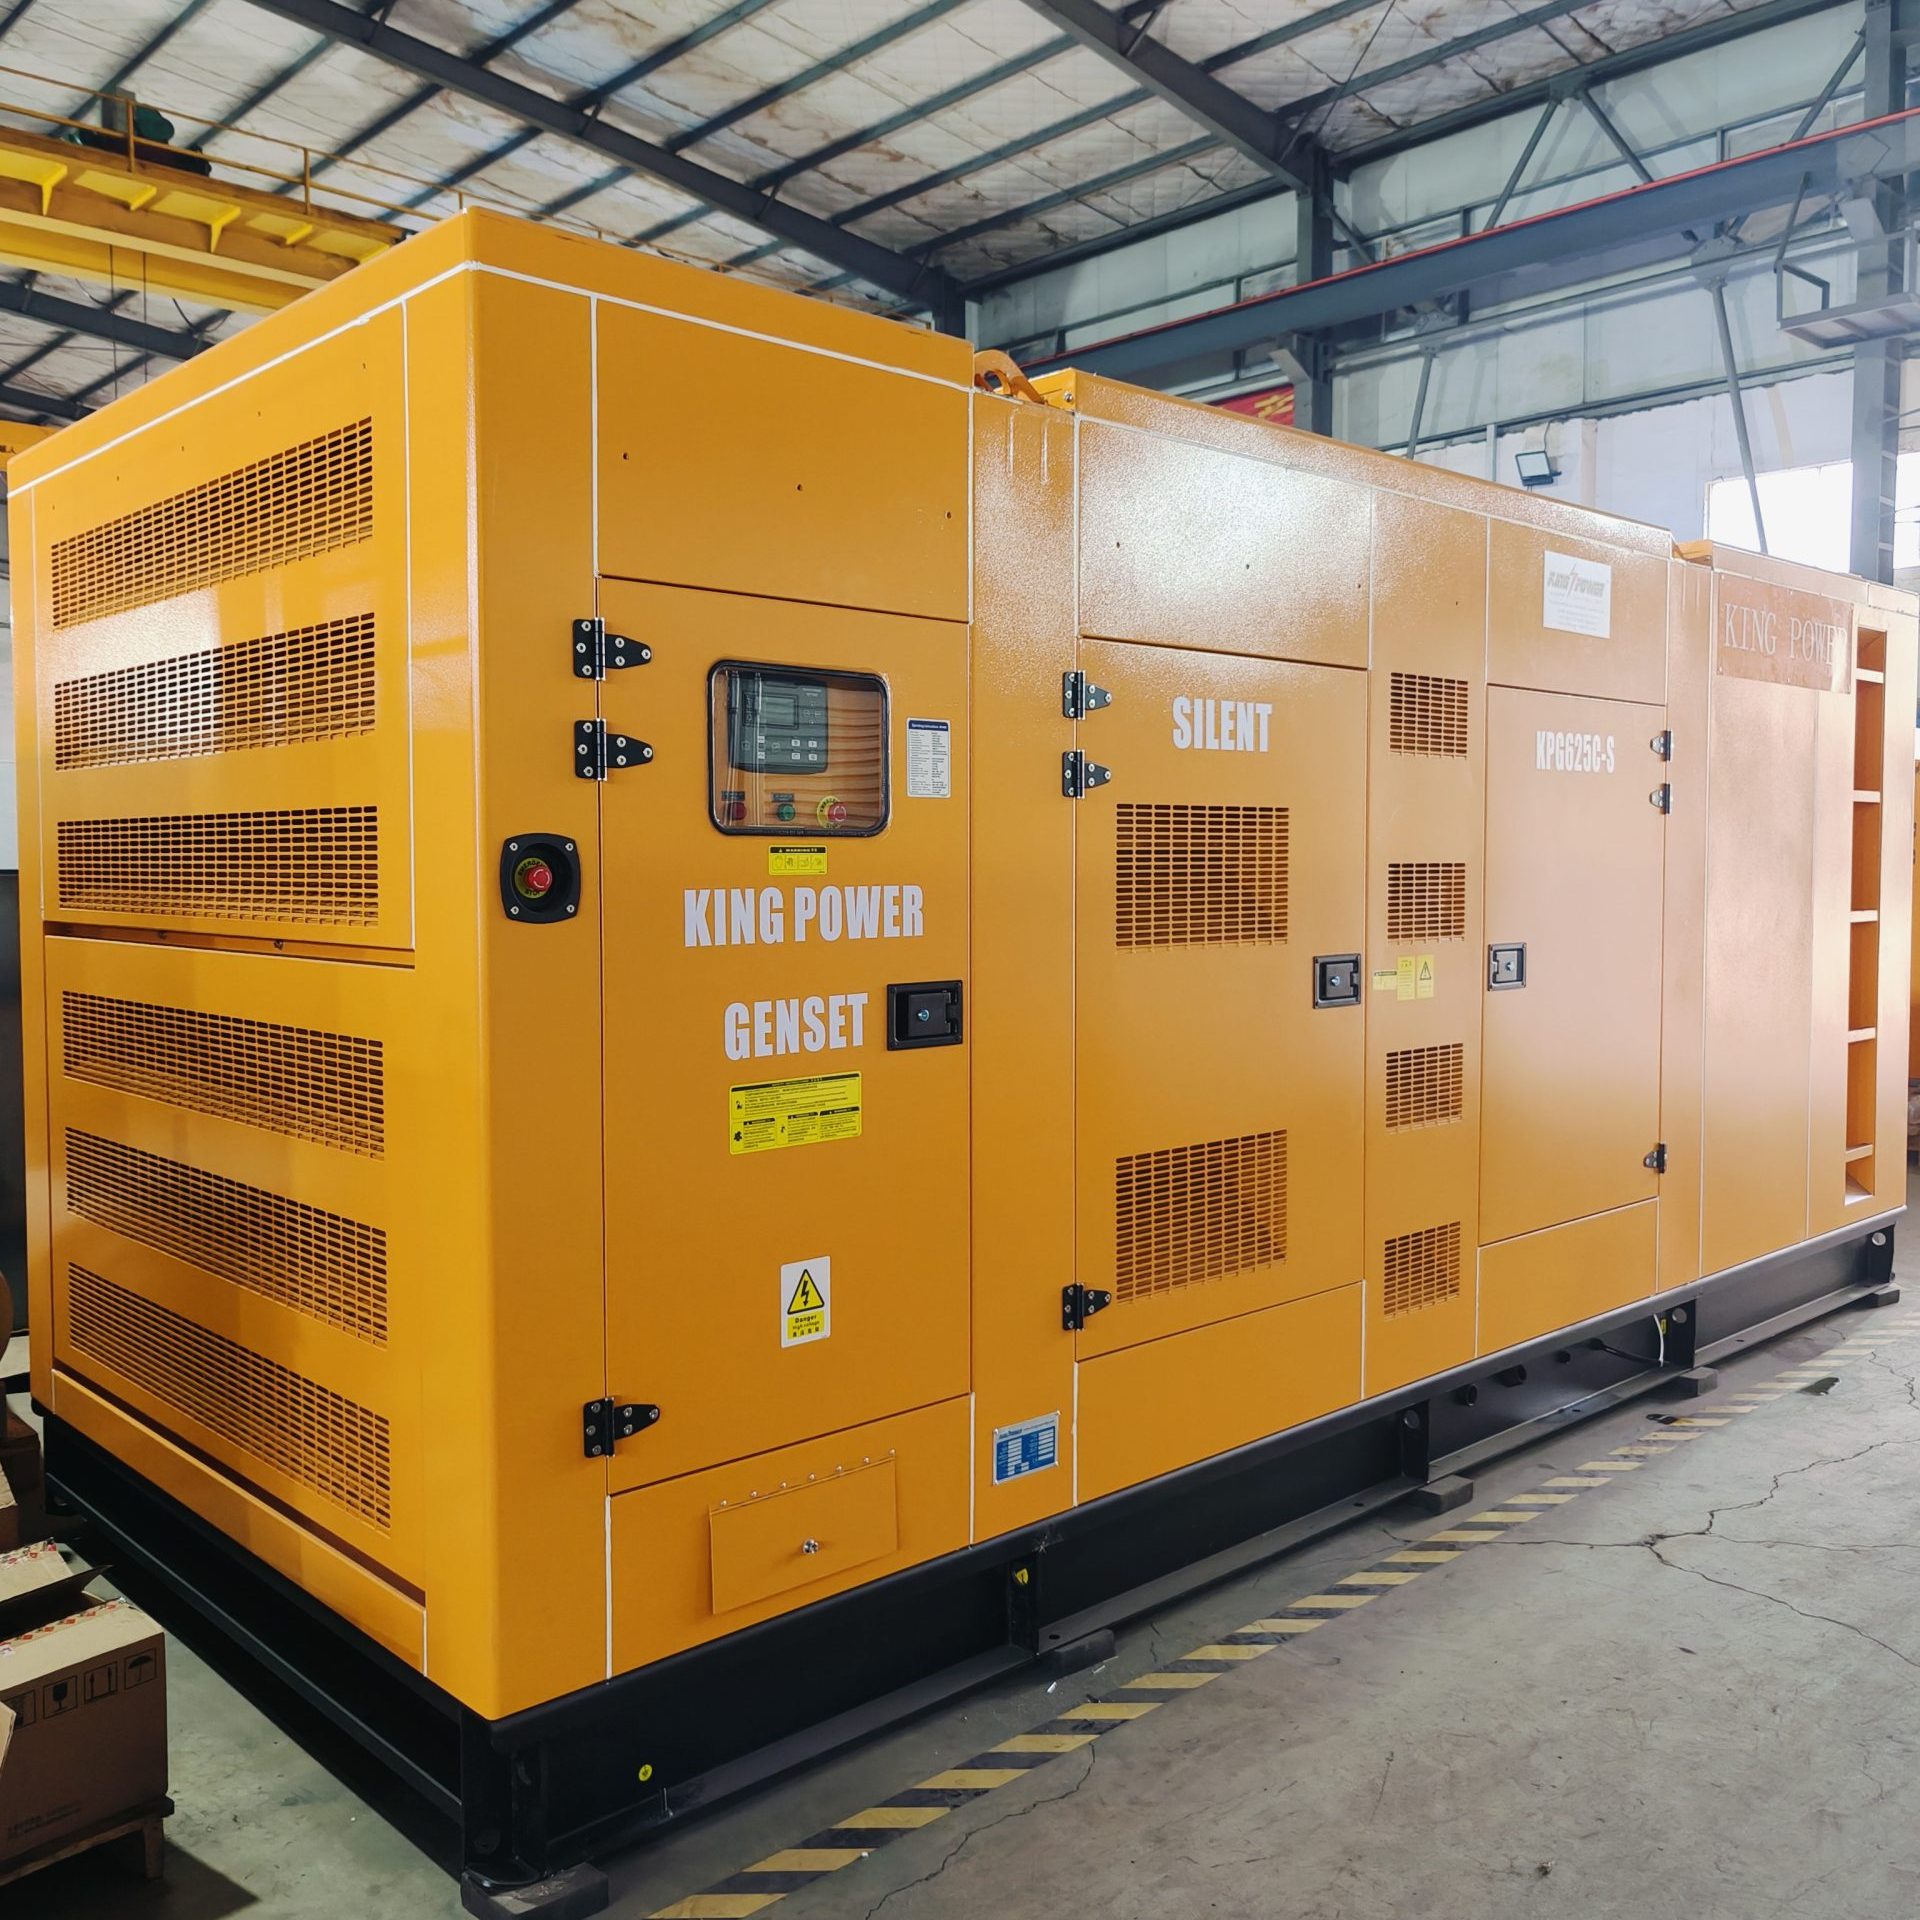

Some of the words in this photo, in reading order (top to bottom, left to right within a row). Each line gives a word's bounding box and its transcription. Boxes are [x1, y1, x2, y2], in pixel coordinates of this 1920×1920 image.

[1724, 603, 1777, 655] KING
[1172, 695, 1273, 752] SILENT
[1536, 730, 1615, 774] KPG625C-S
[684, 887, 785, 947] KING
[794, 885, 924, 942] POWER
[724, 992, 869, 1061] GENSET
[794, 1314, 817, 1323] Danger
